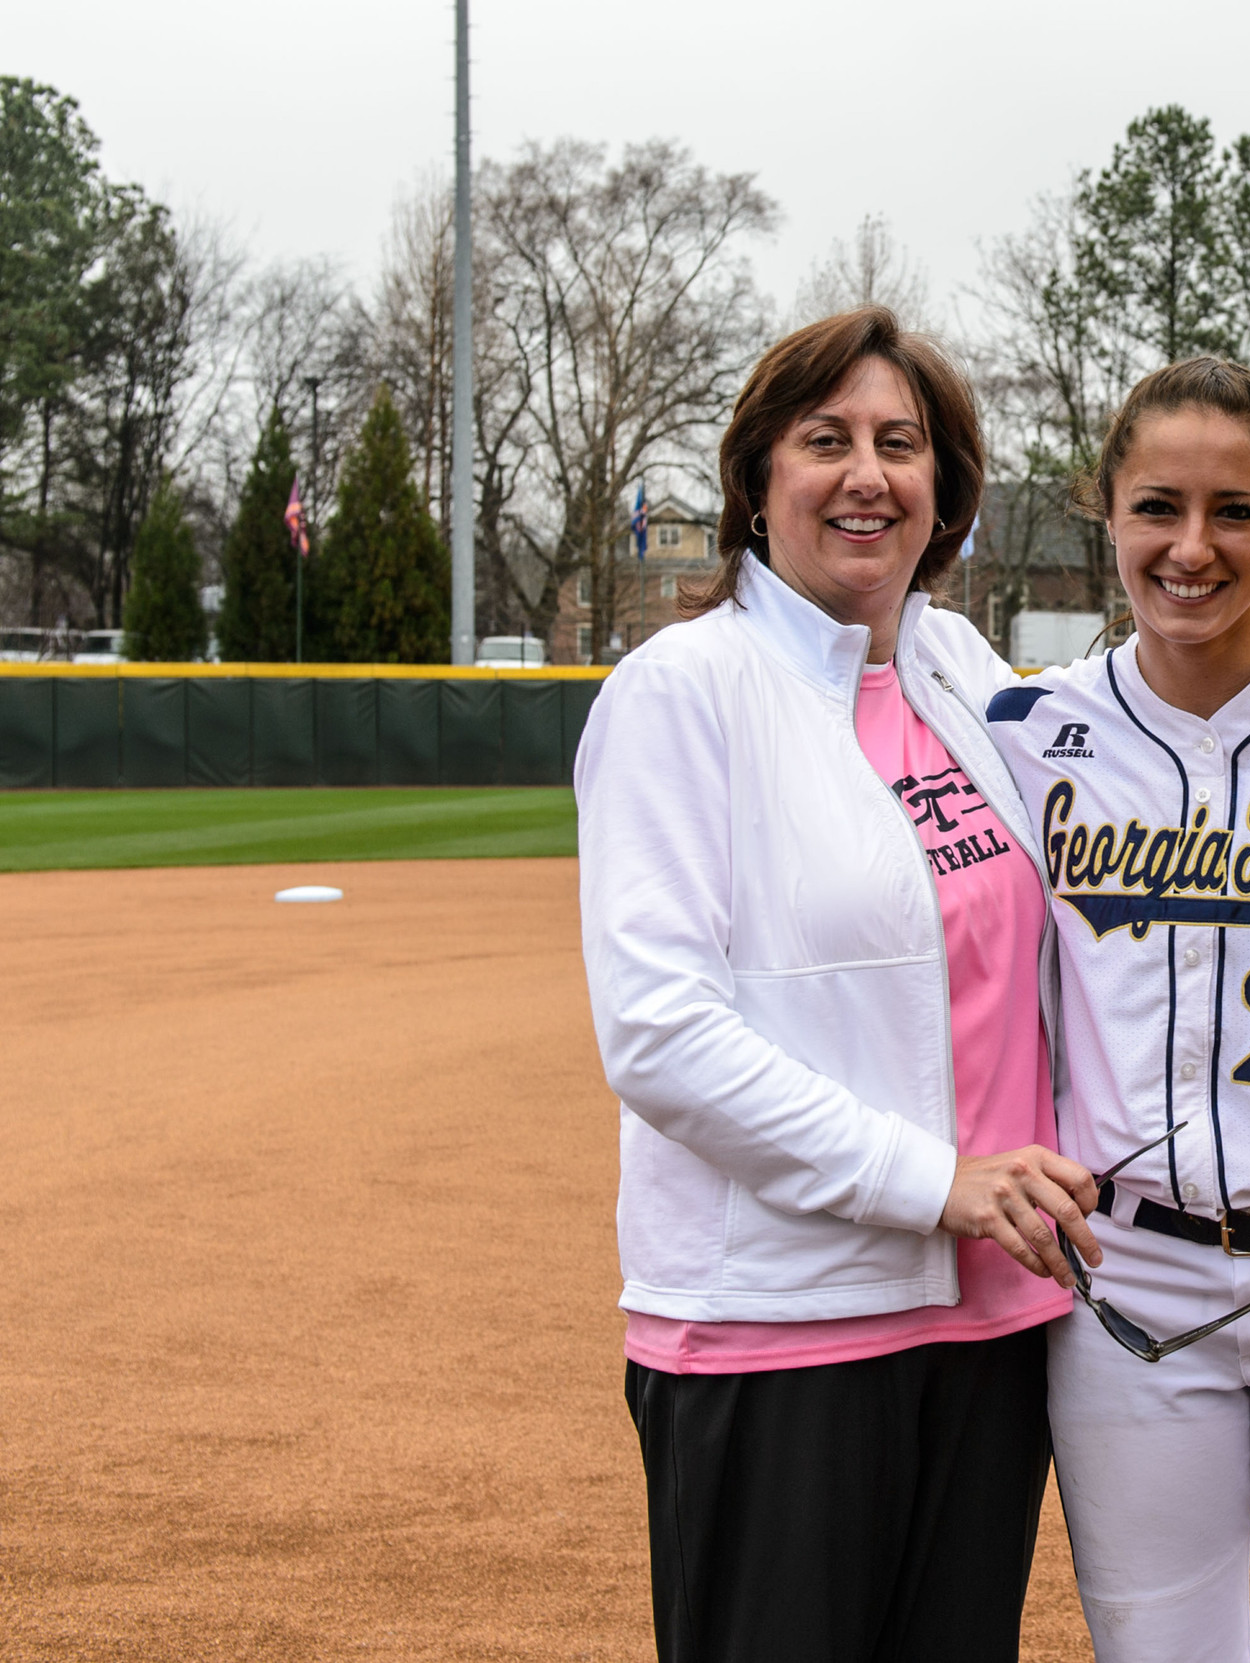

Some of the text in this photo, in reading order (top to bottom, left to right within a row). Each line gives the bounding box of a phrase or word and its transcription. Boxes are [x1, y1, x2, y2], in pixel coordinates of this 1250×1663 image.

[1042, 748, 1096, 759] RUSSELL
[926, 828, 1011, 876] TBALL
[1043, 779, 1233, 941] Georgia
